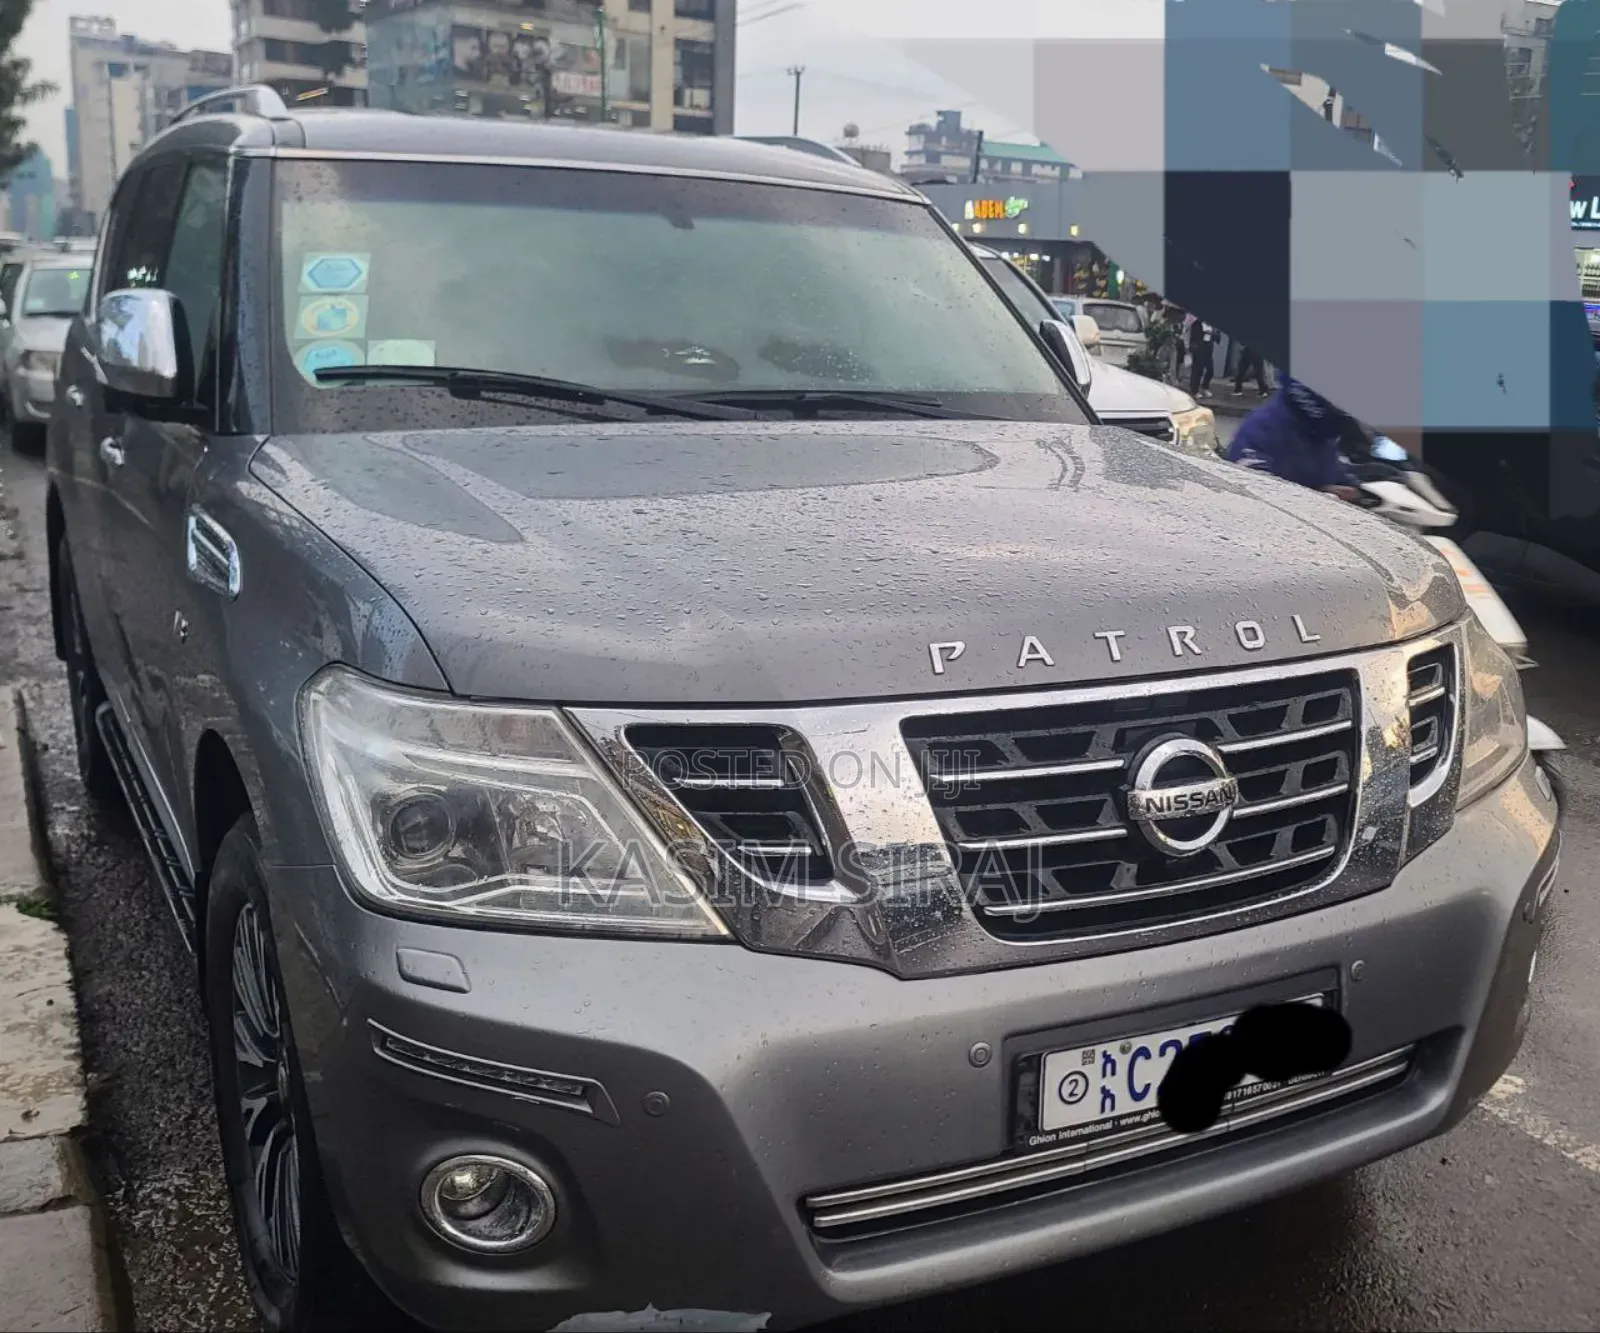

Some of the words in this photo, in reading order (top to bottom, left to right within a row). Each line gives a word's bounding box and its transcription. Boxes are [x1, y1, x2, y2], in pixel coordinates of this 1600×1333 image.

[929, 614, 1320, 674] PATROL
[1145, 785, 1237, 813] NISSAN
[1058, 1120, 1113, 1140] International
